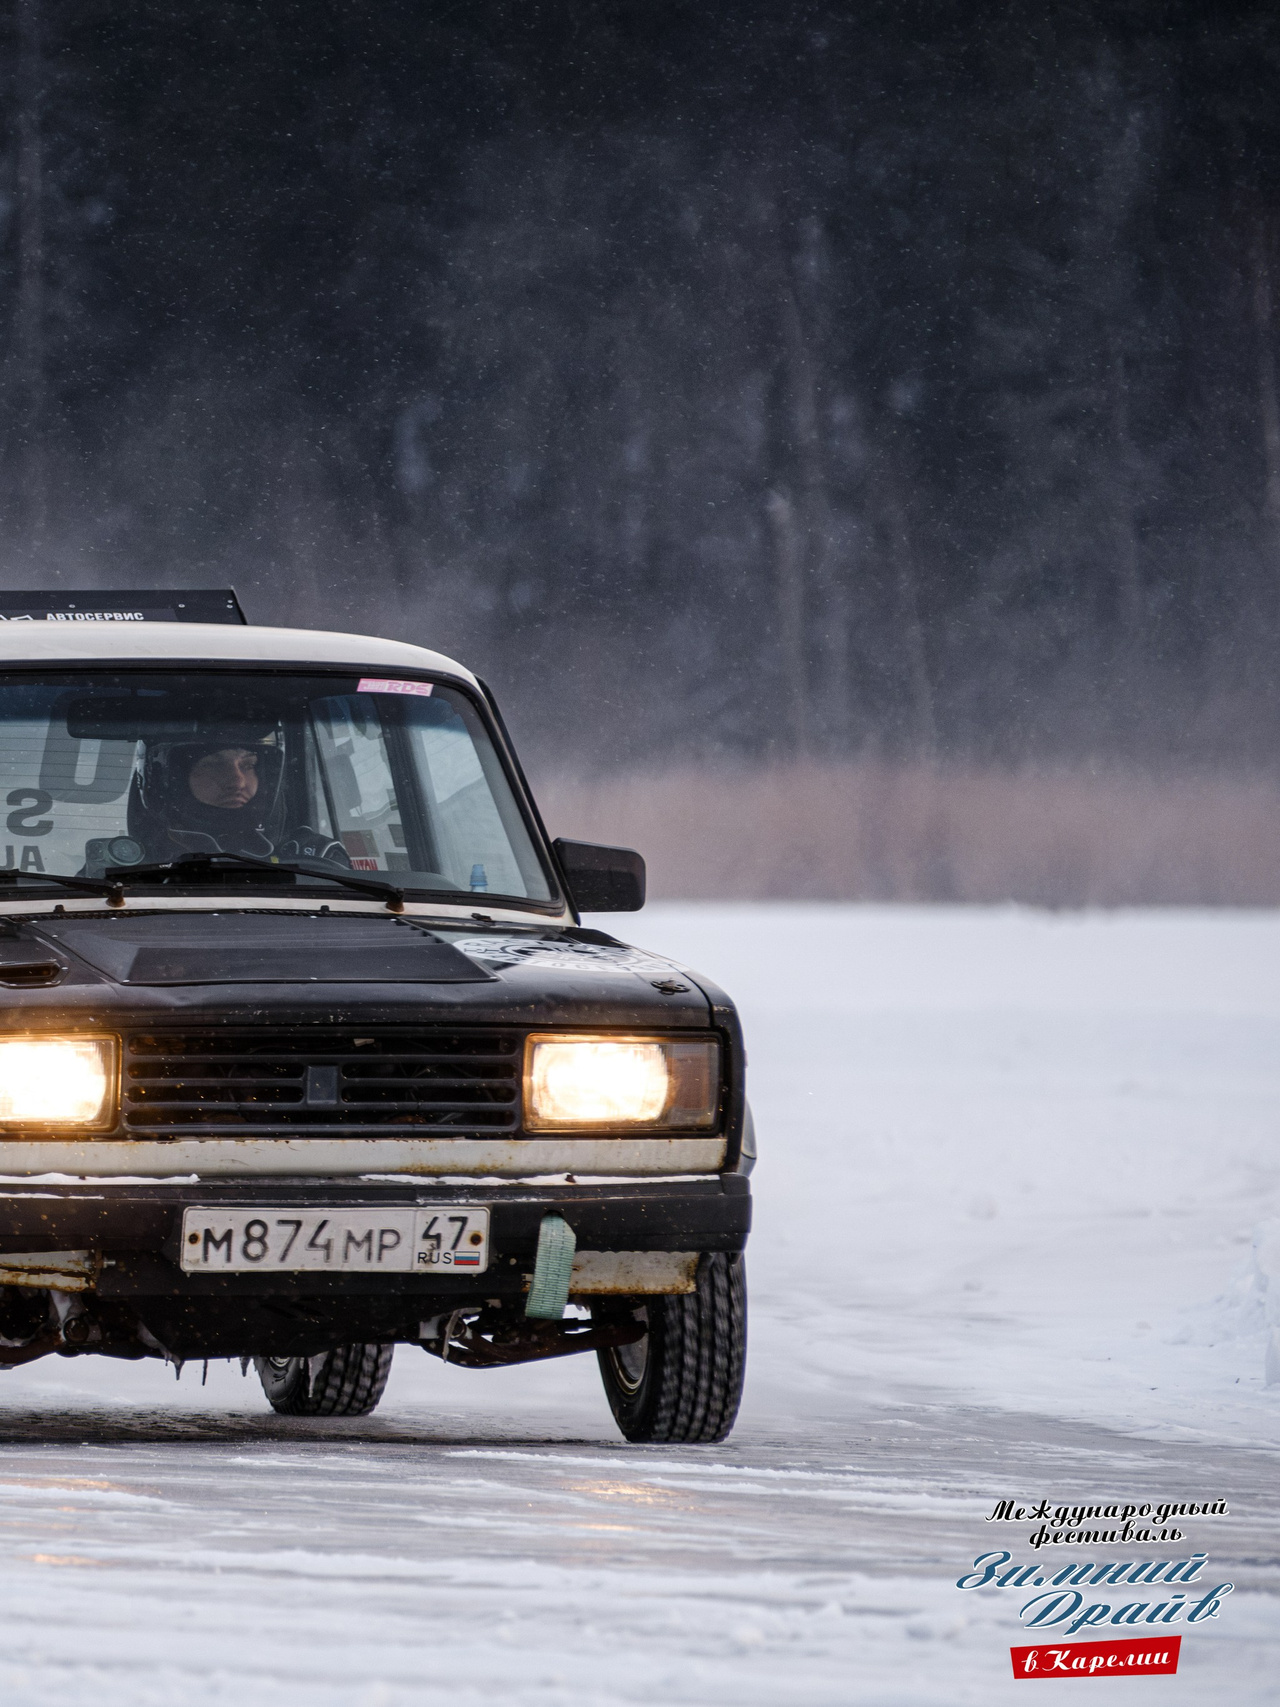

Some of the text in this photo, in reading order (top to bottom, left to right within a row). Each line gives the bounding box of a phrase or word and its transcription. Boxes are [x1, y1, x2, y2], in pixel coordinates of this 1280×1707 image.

[46, 612, 144, 621] АВТОСЕРВИС
[386, 681, 431, 695] RDS
[202, 1216, 469, 1264] М874МР 47
[417, 1251, 452, 1265] RUS
